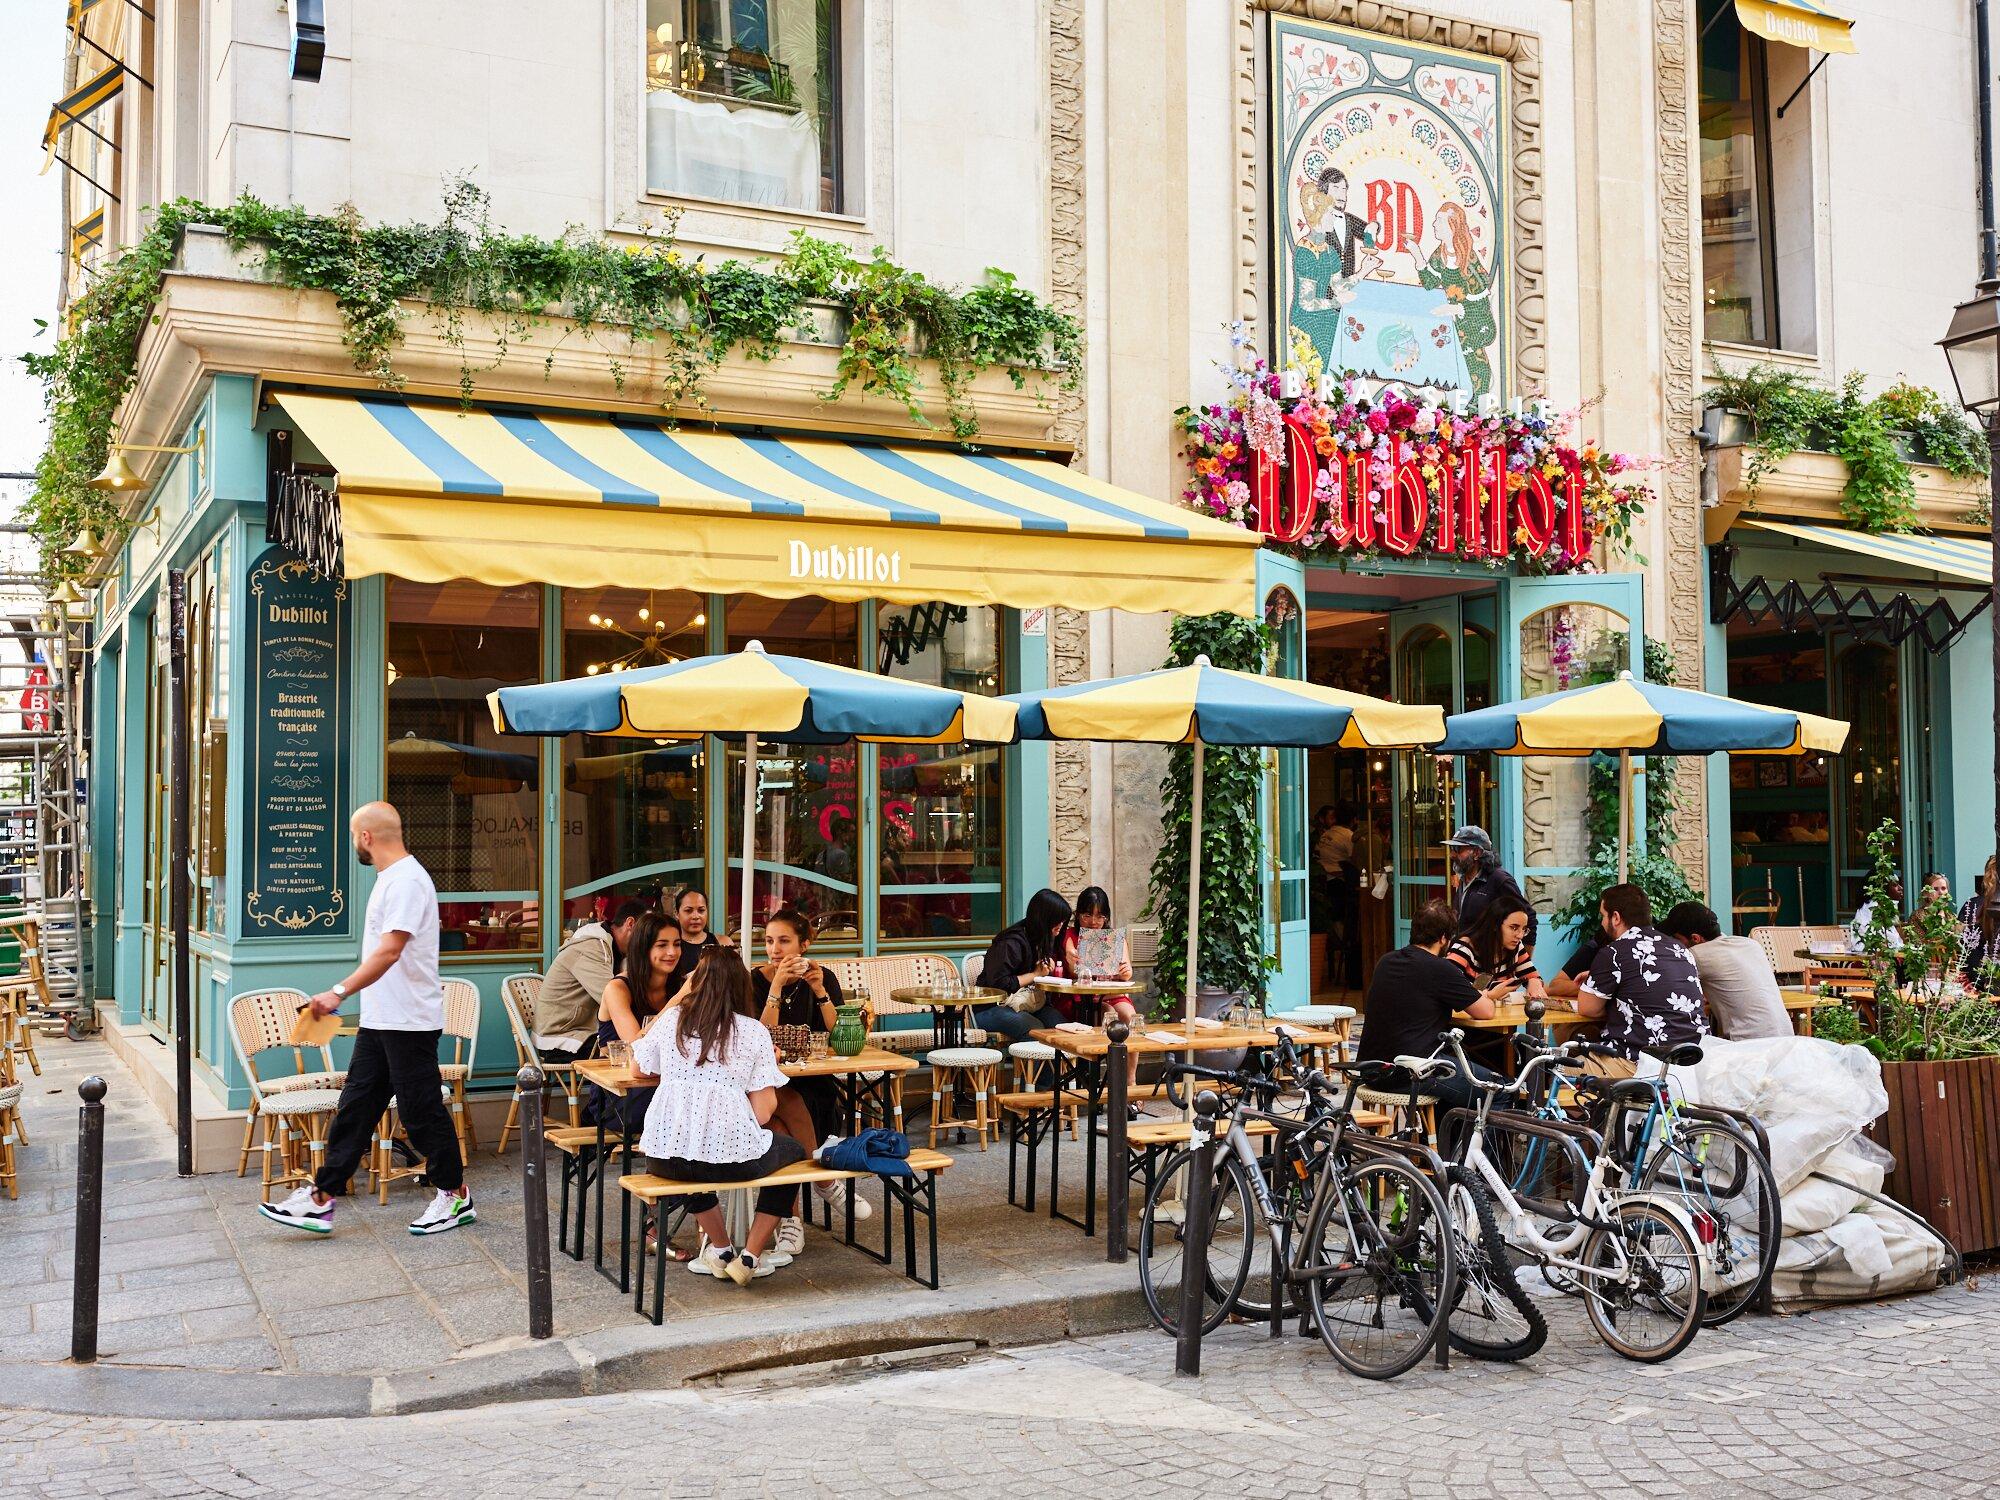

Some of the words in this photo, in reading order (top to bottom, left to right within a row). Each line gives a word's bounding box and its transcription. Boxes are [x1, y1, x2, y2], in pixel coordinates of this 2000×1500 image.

[1765, 10, 1819, 44] Dubillot
[1280, 370, 1555, 426] BRASSERIE
[1248, 414, 1588, 565] Dubillot
[787, 539, 901, 583] Dubillot
[269, 604, 329, 624] Dubillot
[263, 637, 282, 647] TEMPLE
[297, 636, 315, 644] BONNE
[278, 692, 318, 704] Brasserie
[270, 707, 325, 718] traditionnelle
[277, 721, 318, 735] française
[297, 796, 323, 804] FRANÇAIS
[266, 803, 284, 811] FRAIS
[304, 803, 327, 812] SAISON
[266, 885, 286, 894] DIRECT
[286, 884, 325, 894] PRODUCTEURS
